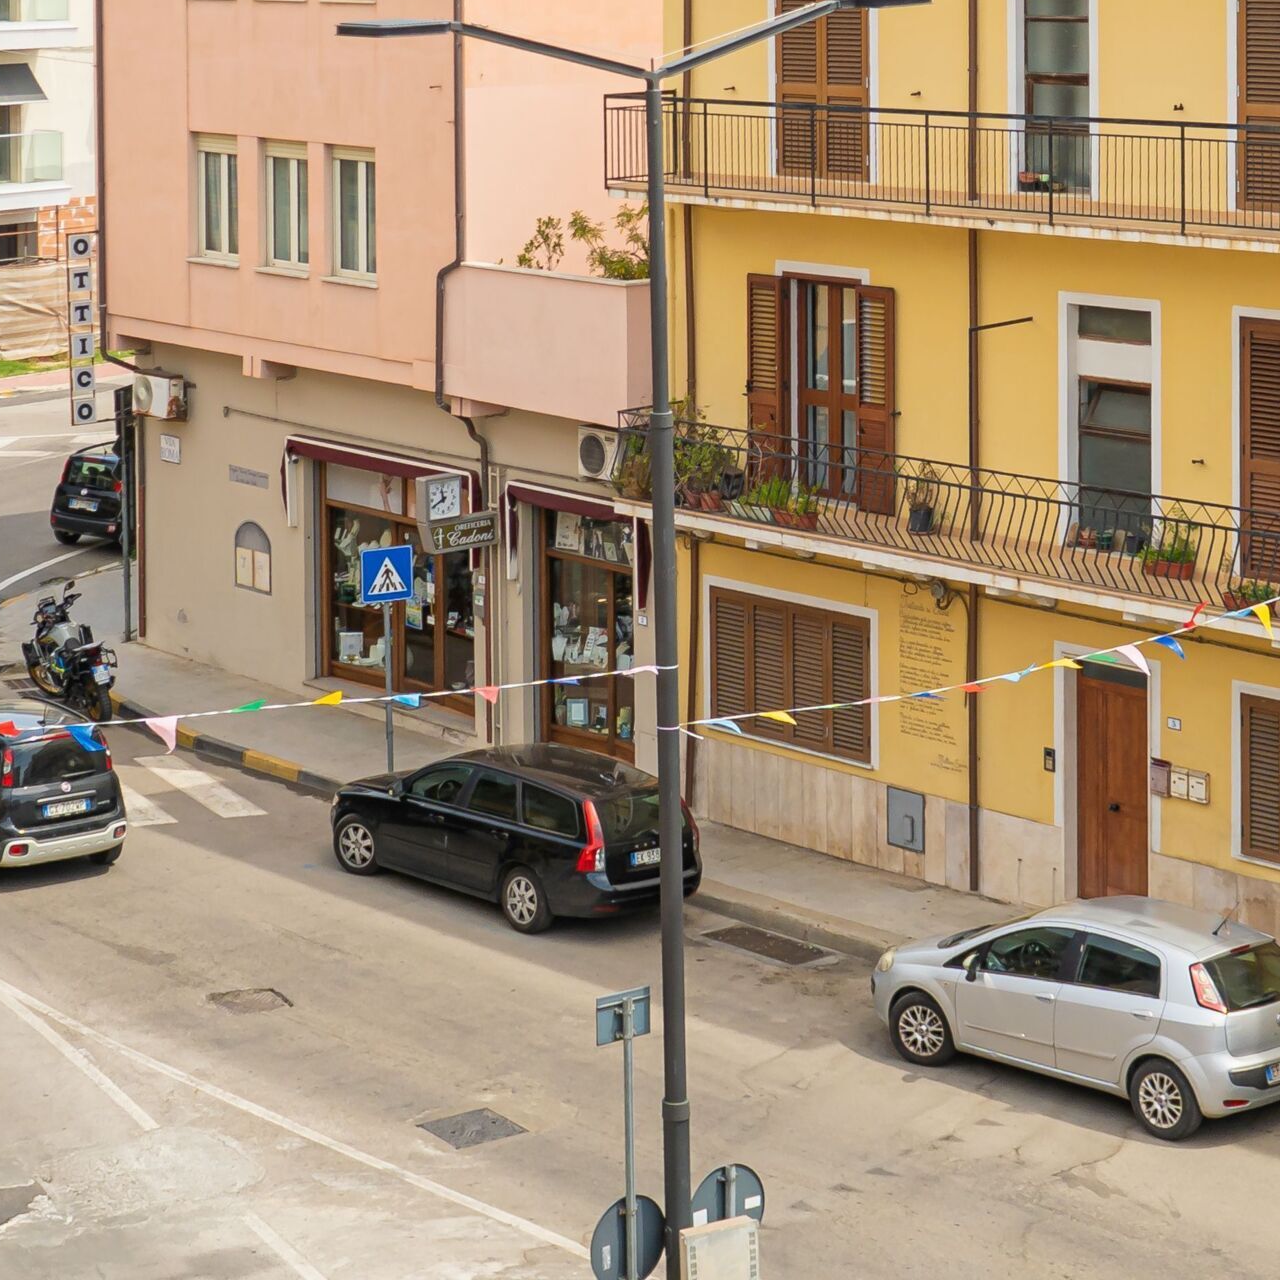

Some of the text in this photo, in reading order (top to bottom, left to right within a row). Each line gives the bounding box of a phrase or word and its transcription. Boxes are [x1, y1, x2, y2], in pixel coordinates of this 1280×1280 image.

[73, 238, 93, 420] OTTICO
[160, 447, 179, 459] ROMA
[455, 519, 491, 531] OREFICERIA
[446, 529, 494, 547] Cadoni
